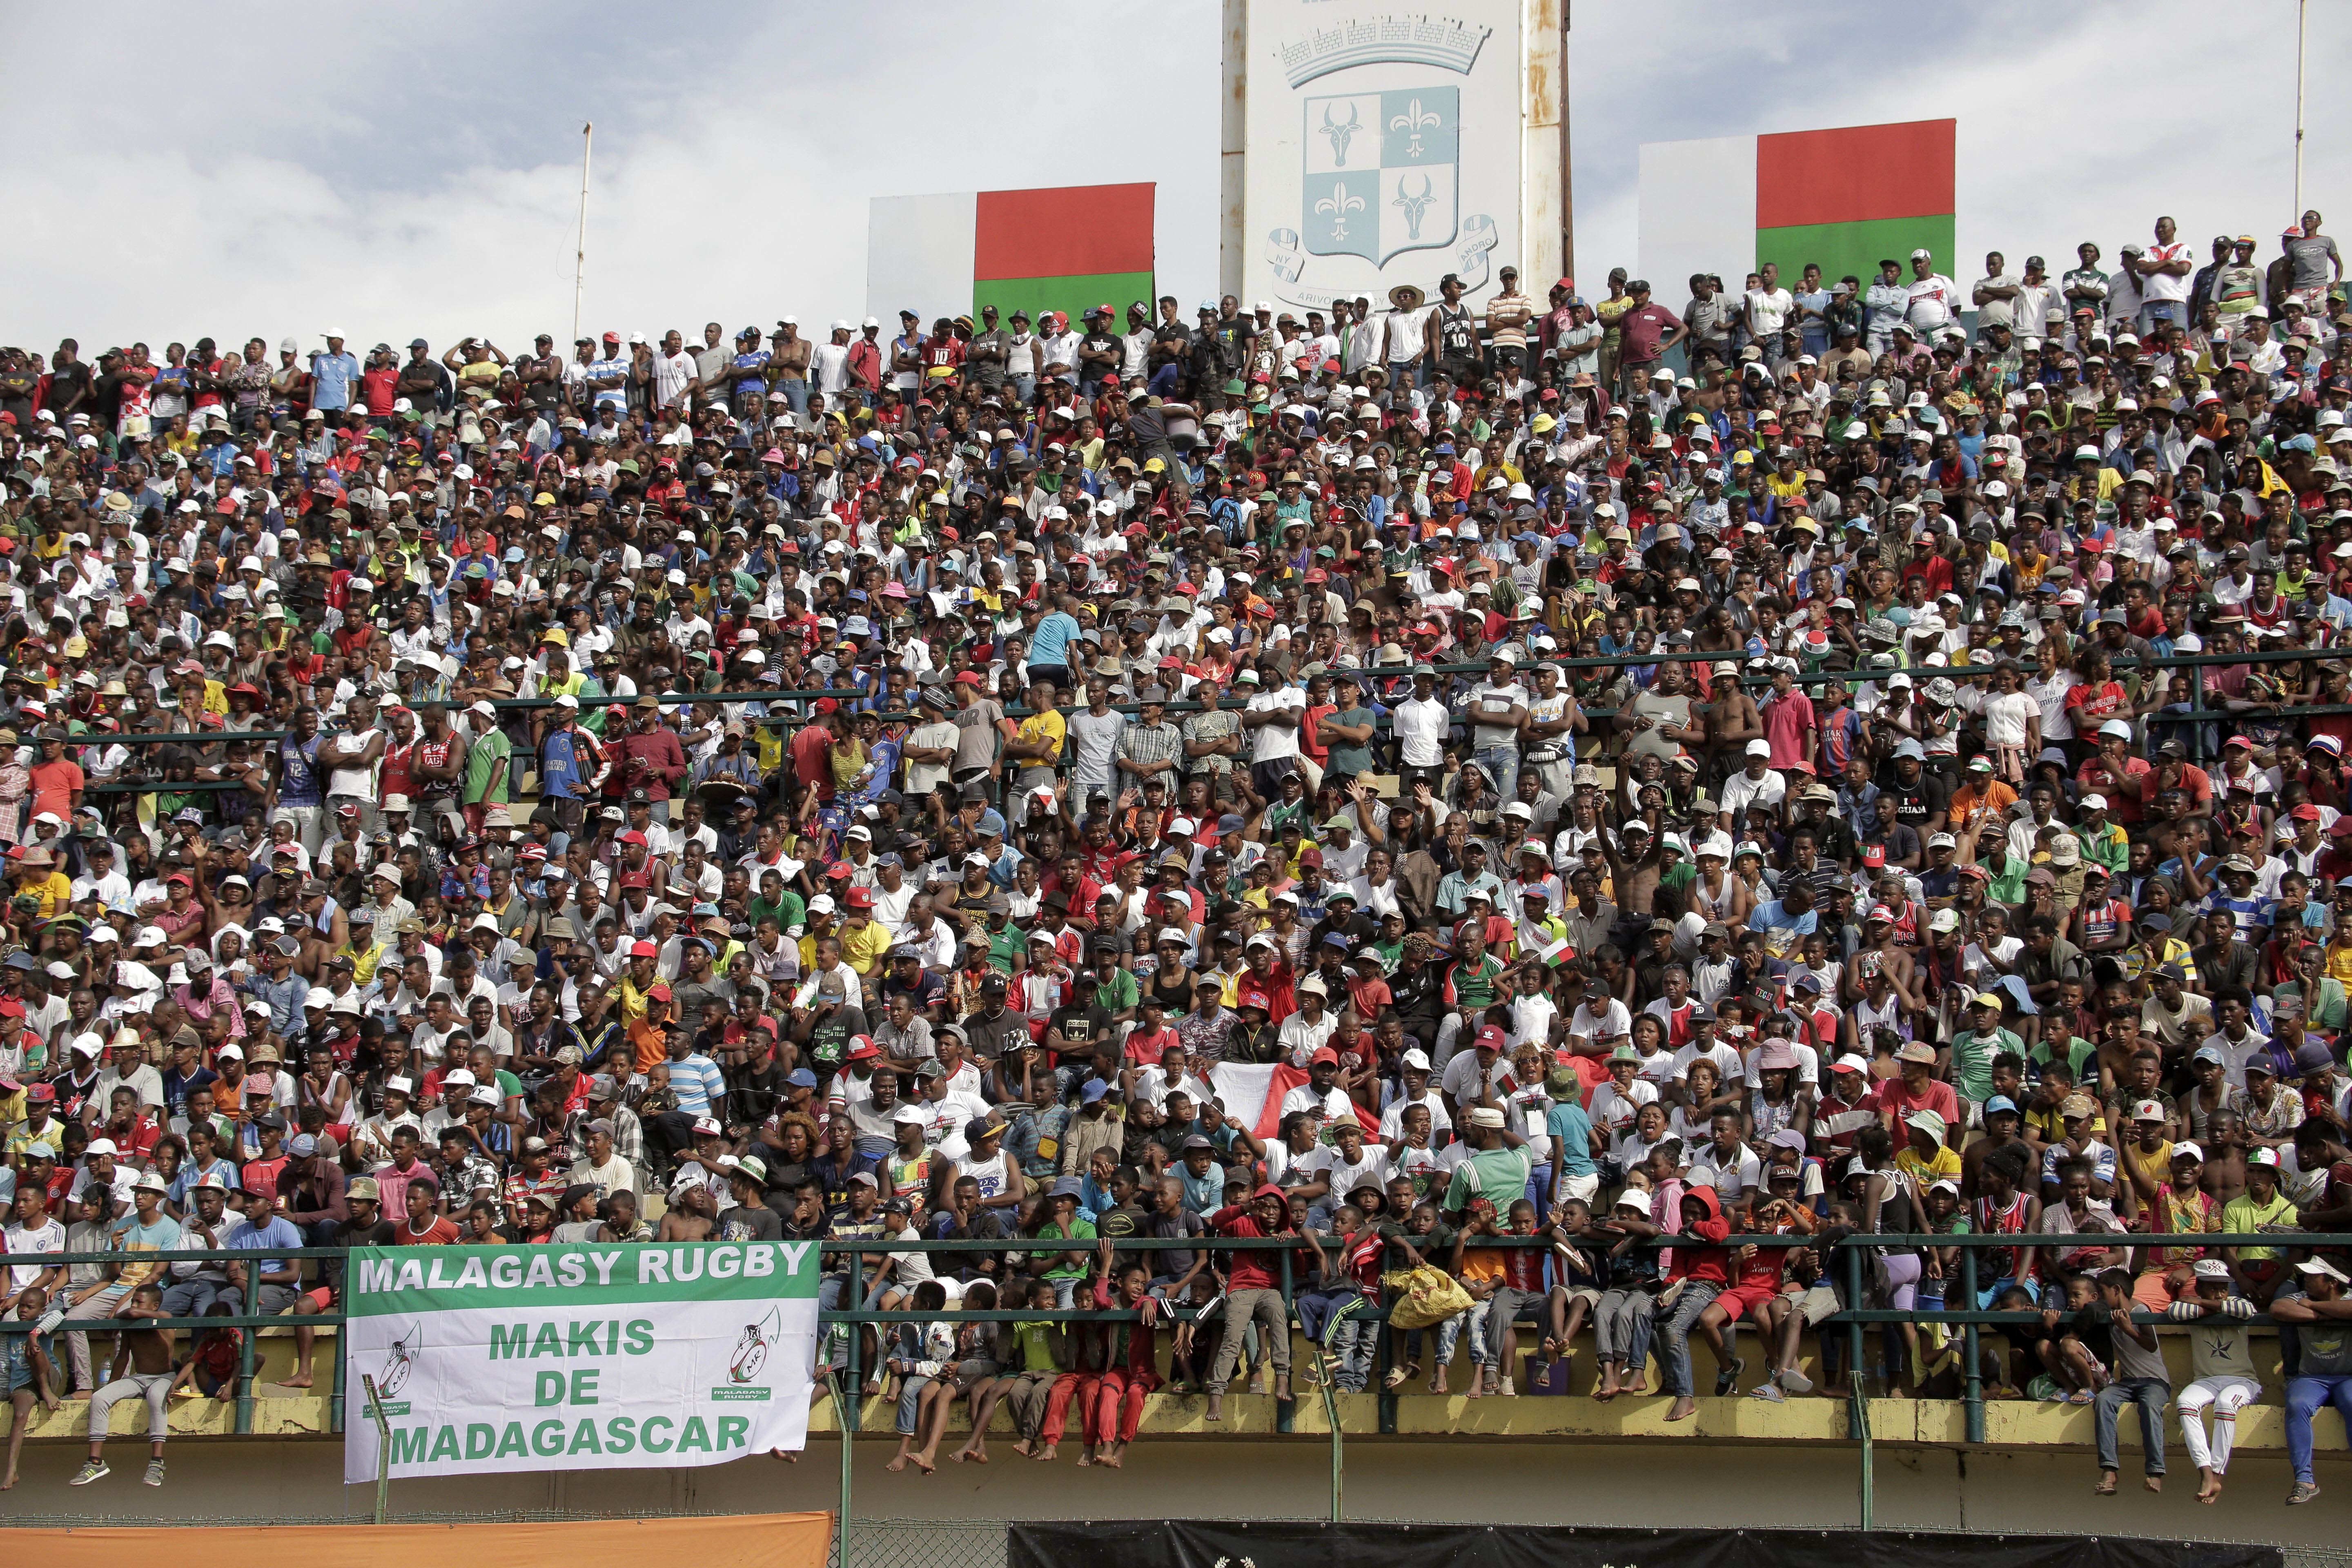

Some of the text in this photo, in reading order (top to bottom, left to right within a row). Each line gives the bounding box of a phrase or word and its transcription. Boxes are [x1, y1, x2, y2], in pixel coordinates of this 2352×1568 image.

[1460, 238, 1492, 262] ANDRO
[1275, 254, 1291, 265] NY
[1373, 296, 1385, 306] SY
[1451, 333, 1468, 347] 10
[935, 350, 949, 365] 10
[1527, 751, 1557, 762] PUMA
[290, 762, 302, 777] 12
[1898, 805, 1926, 814] GUAM
[1532, 931, 1552, 946] MADAGAS
[1755, 986, 1773, 1001] VEGAS
[359, 1241, 813, 1294] MALAGASY RUGBY
[490, 1320, 653, 1360] MAKIS
[535, 1370, 599, 1406] DE
[391, 1417, 749, 1464] MADAGASCAR
